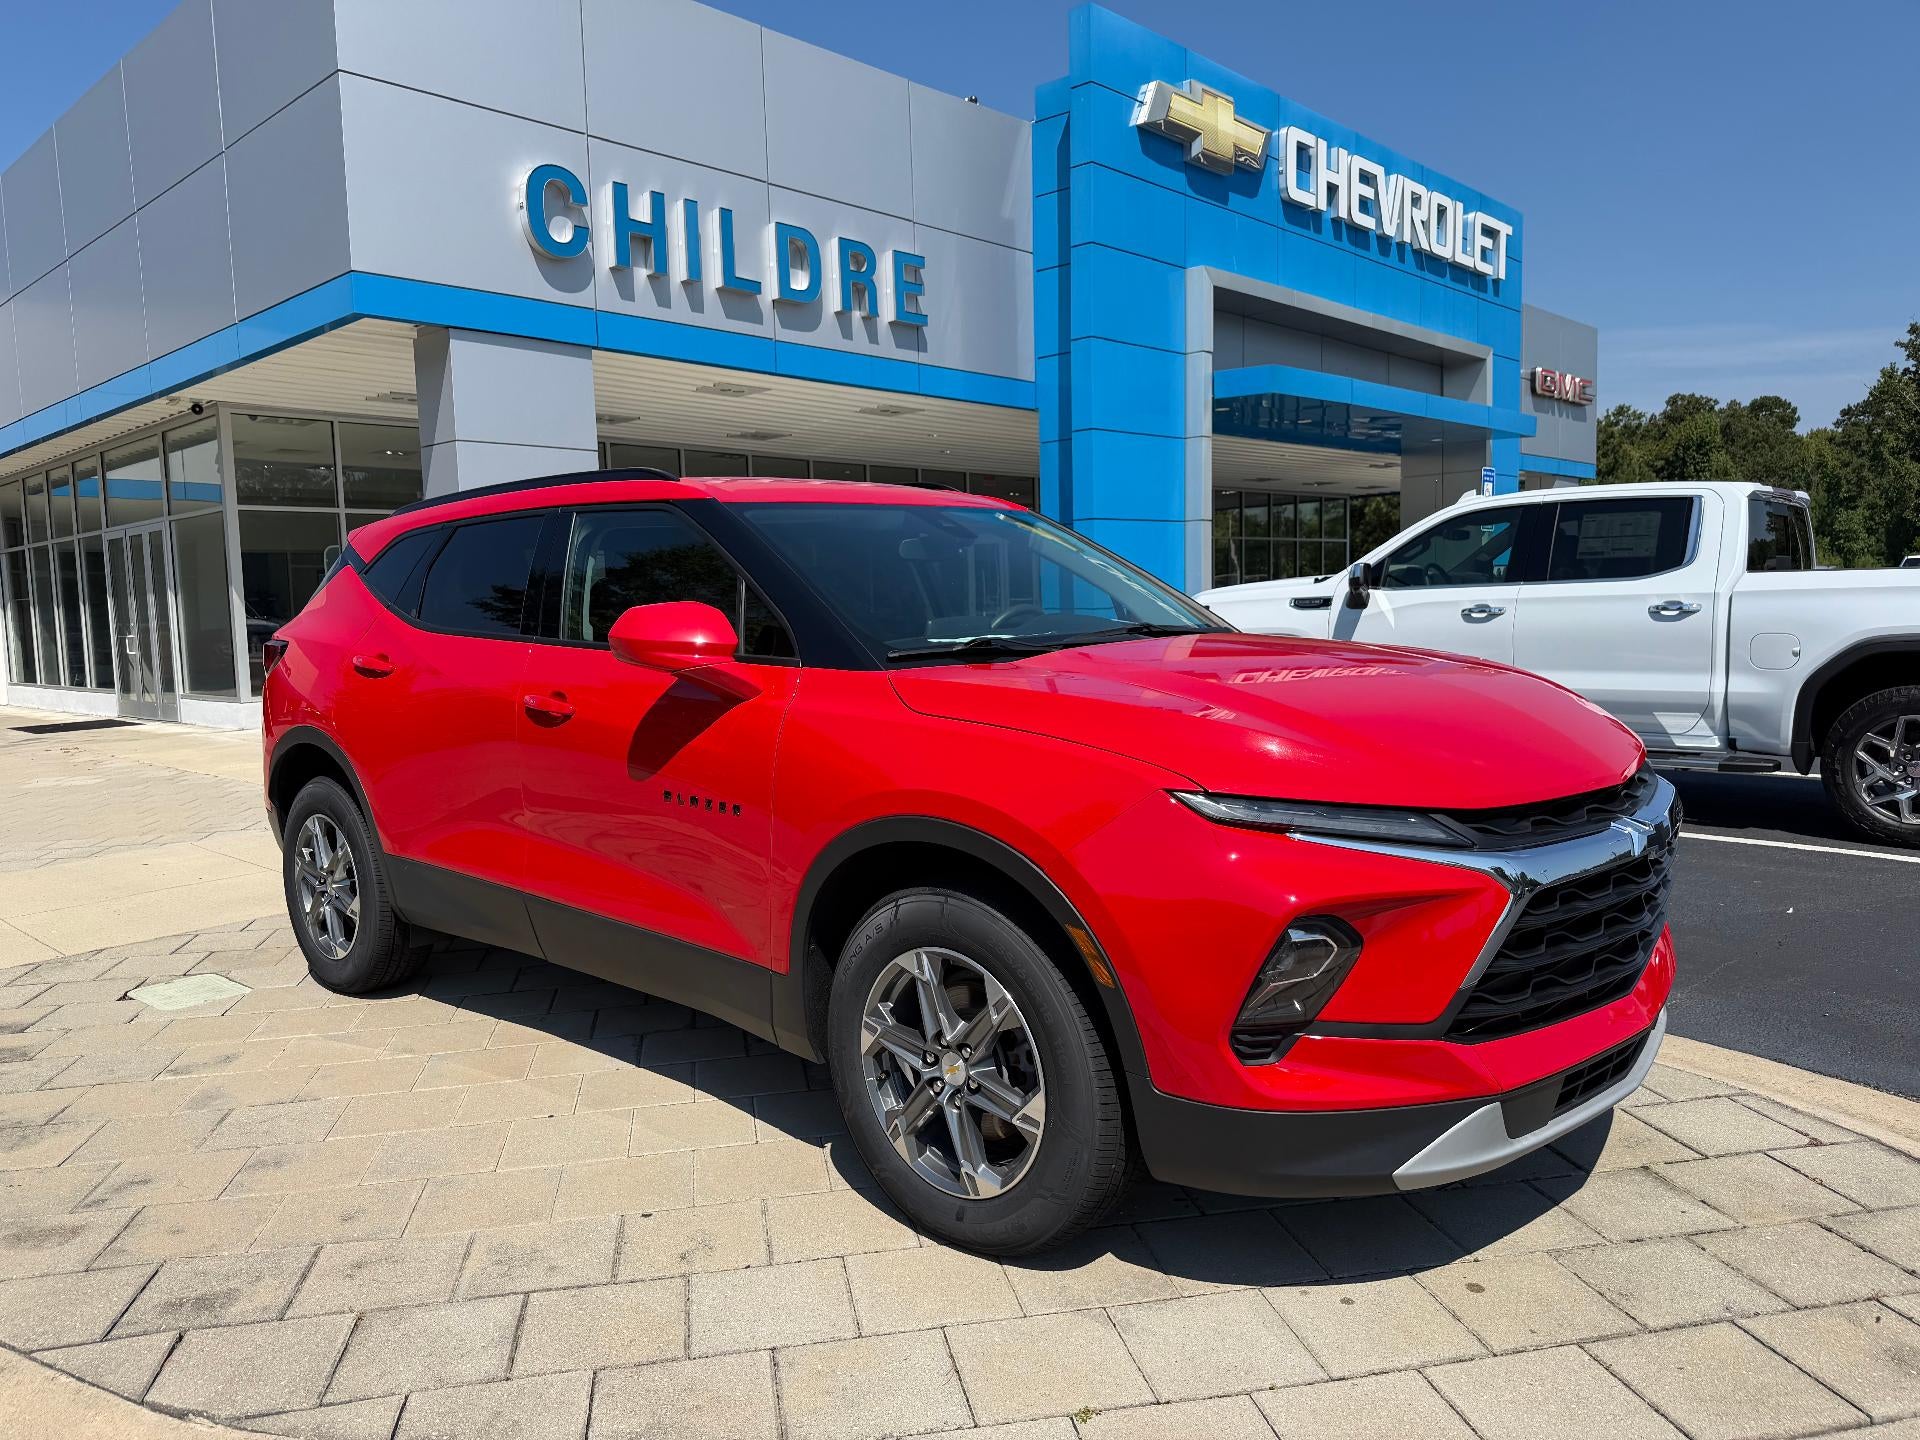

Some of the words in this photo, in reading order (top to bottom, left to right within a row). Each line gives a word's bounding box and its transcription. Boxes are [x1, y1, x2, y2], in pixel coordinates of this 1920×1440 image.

[1279, 125, 1513, 281] CHEVROLET
[519, 163, 928, 328] CHILDRE
[1531, 367, 1593, 405] GMC
[663, 789, 741, 816] BLAZER
[865, 923, 883, 944] A/S
